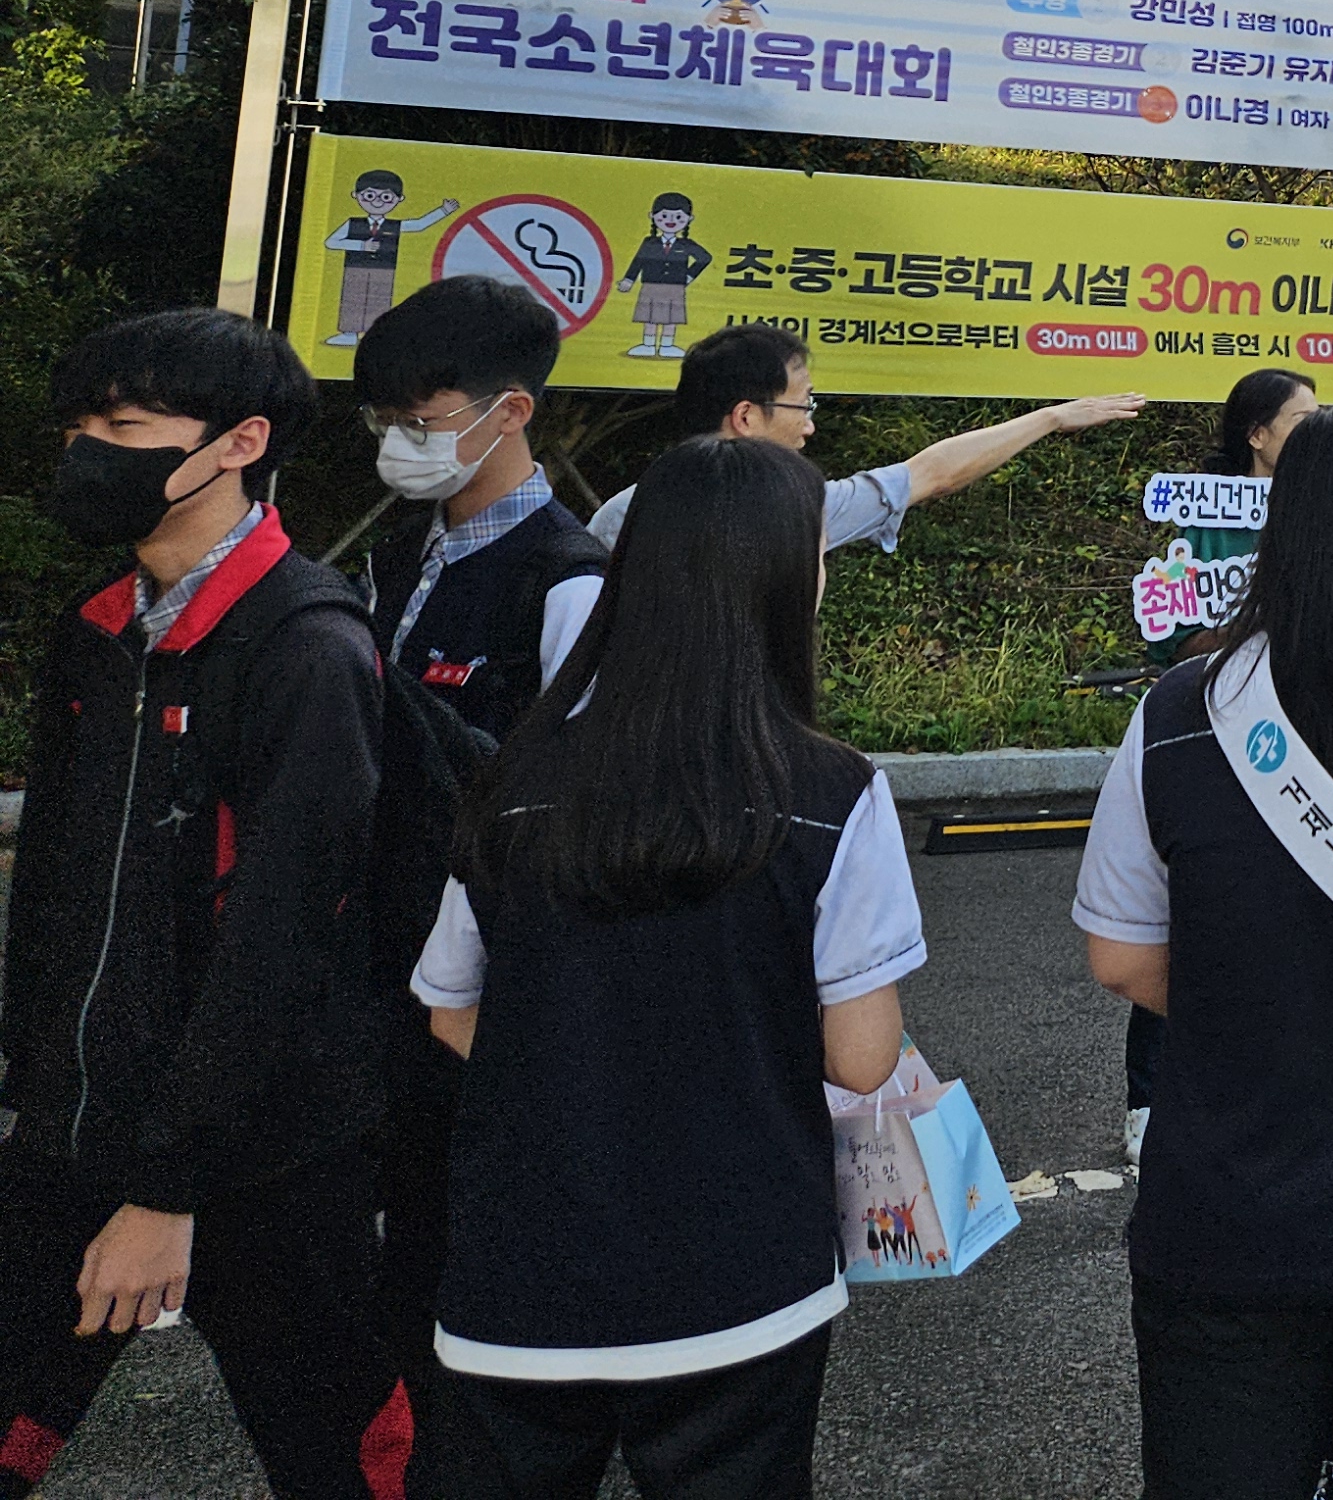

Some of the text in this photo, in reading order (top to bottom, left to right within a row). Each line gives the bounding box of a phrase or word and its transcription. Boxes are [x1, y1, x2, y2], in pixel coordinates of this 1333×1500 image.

[1236, 12, 1276, 33] 접영
[1012, 36, 1136, 66] 철인3종경기
[1191, 48, 1275, 79] 김준기
[1008, 83, 1132, 112] 철인3종경기
[1185, 94, 1269, 125] 이나경
[1290, 109, 1330, 130] 여자
[1043, 263, 1129, 308] 시설
[1138, 263, 1260, 315] 30m
[818, 316, 1019, 350] 경계선으로부터
[1036, 330, 1090, 350] 30m
[1096, 331, 1137, 352] 이내
[1156, 331, 1204, 354] 에서
[1212, 332, 1259, 357] 흡연
[1269, 336, 1290, 358] 시
[1152, 480, 1268, 522] #정신건강
